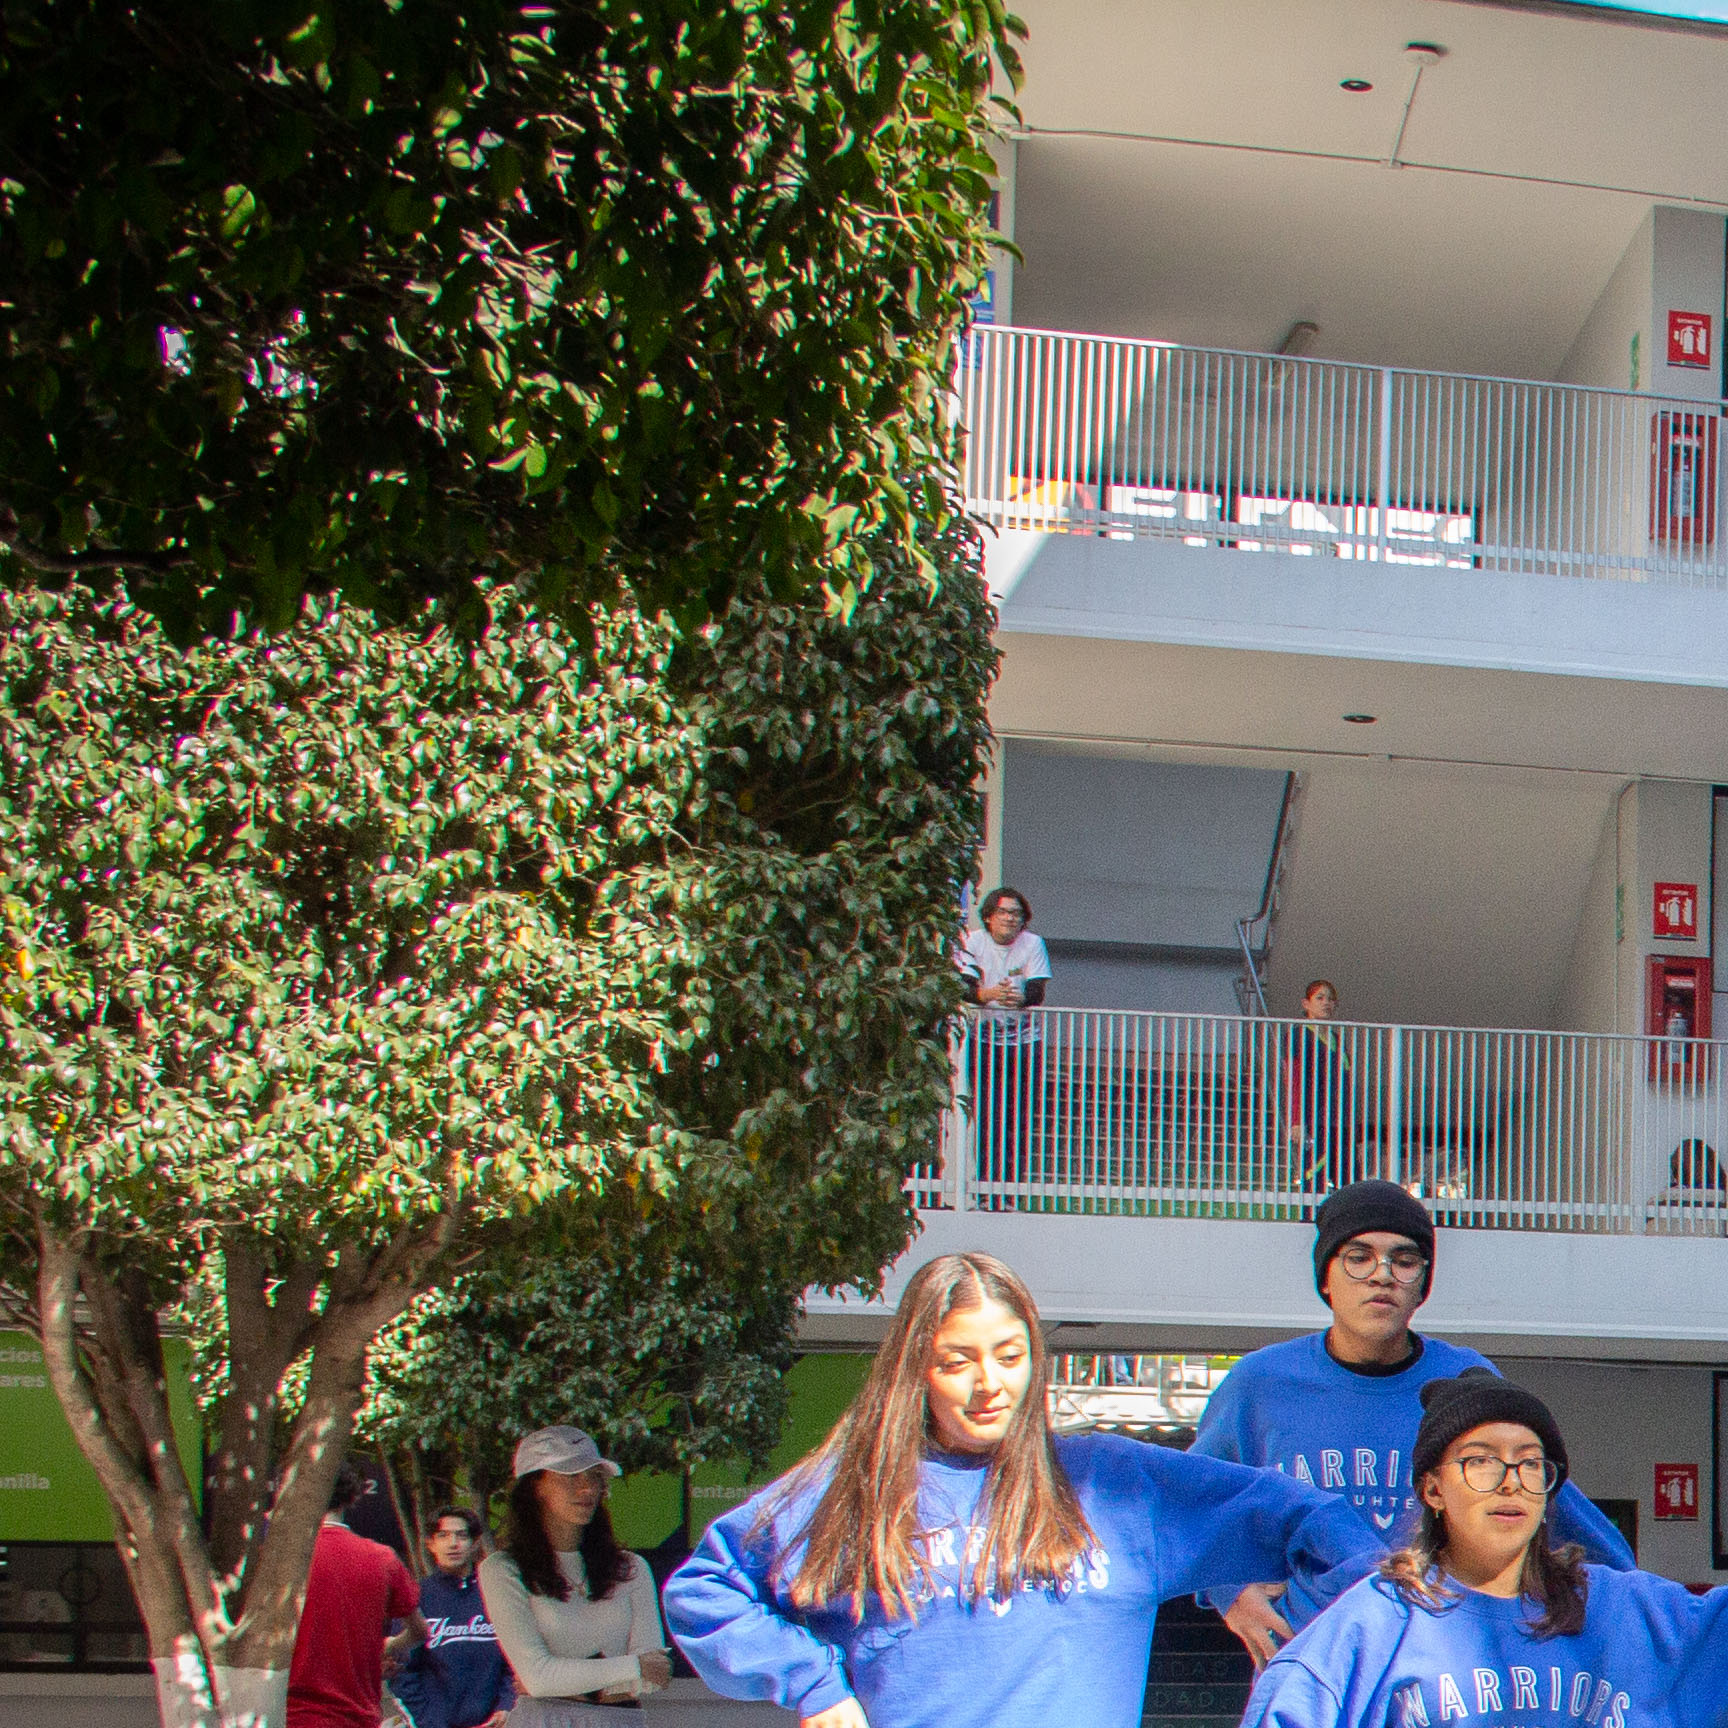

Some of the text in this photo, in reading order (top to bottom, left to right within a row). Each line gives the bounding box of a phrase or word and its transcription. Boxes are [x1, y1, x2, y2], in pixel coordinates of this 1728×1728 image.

[0, 1348, 42, 1364] cios
[0, 1374, 46, 1389] ares
[1278, 1448, 1413, 1489] ARRI
[0, 1472, 50, 1490] nilla
[427, 1614, 499, 1648] Yankee
